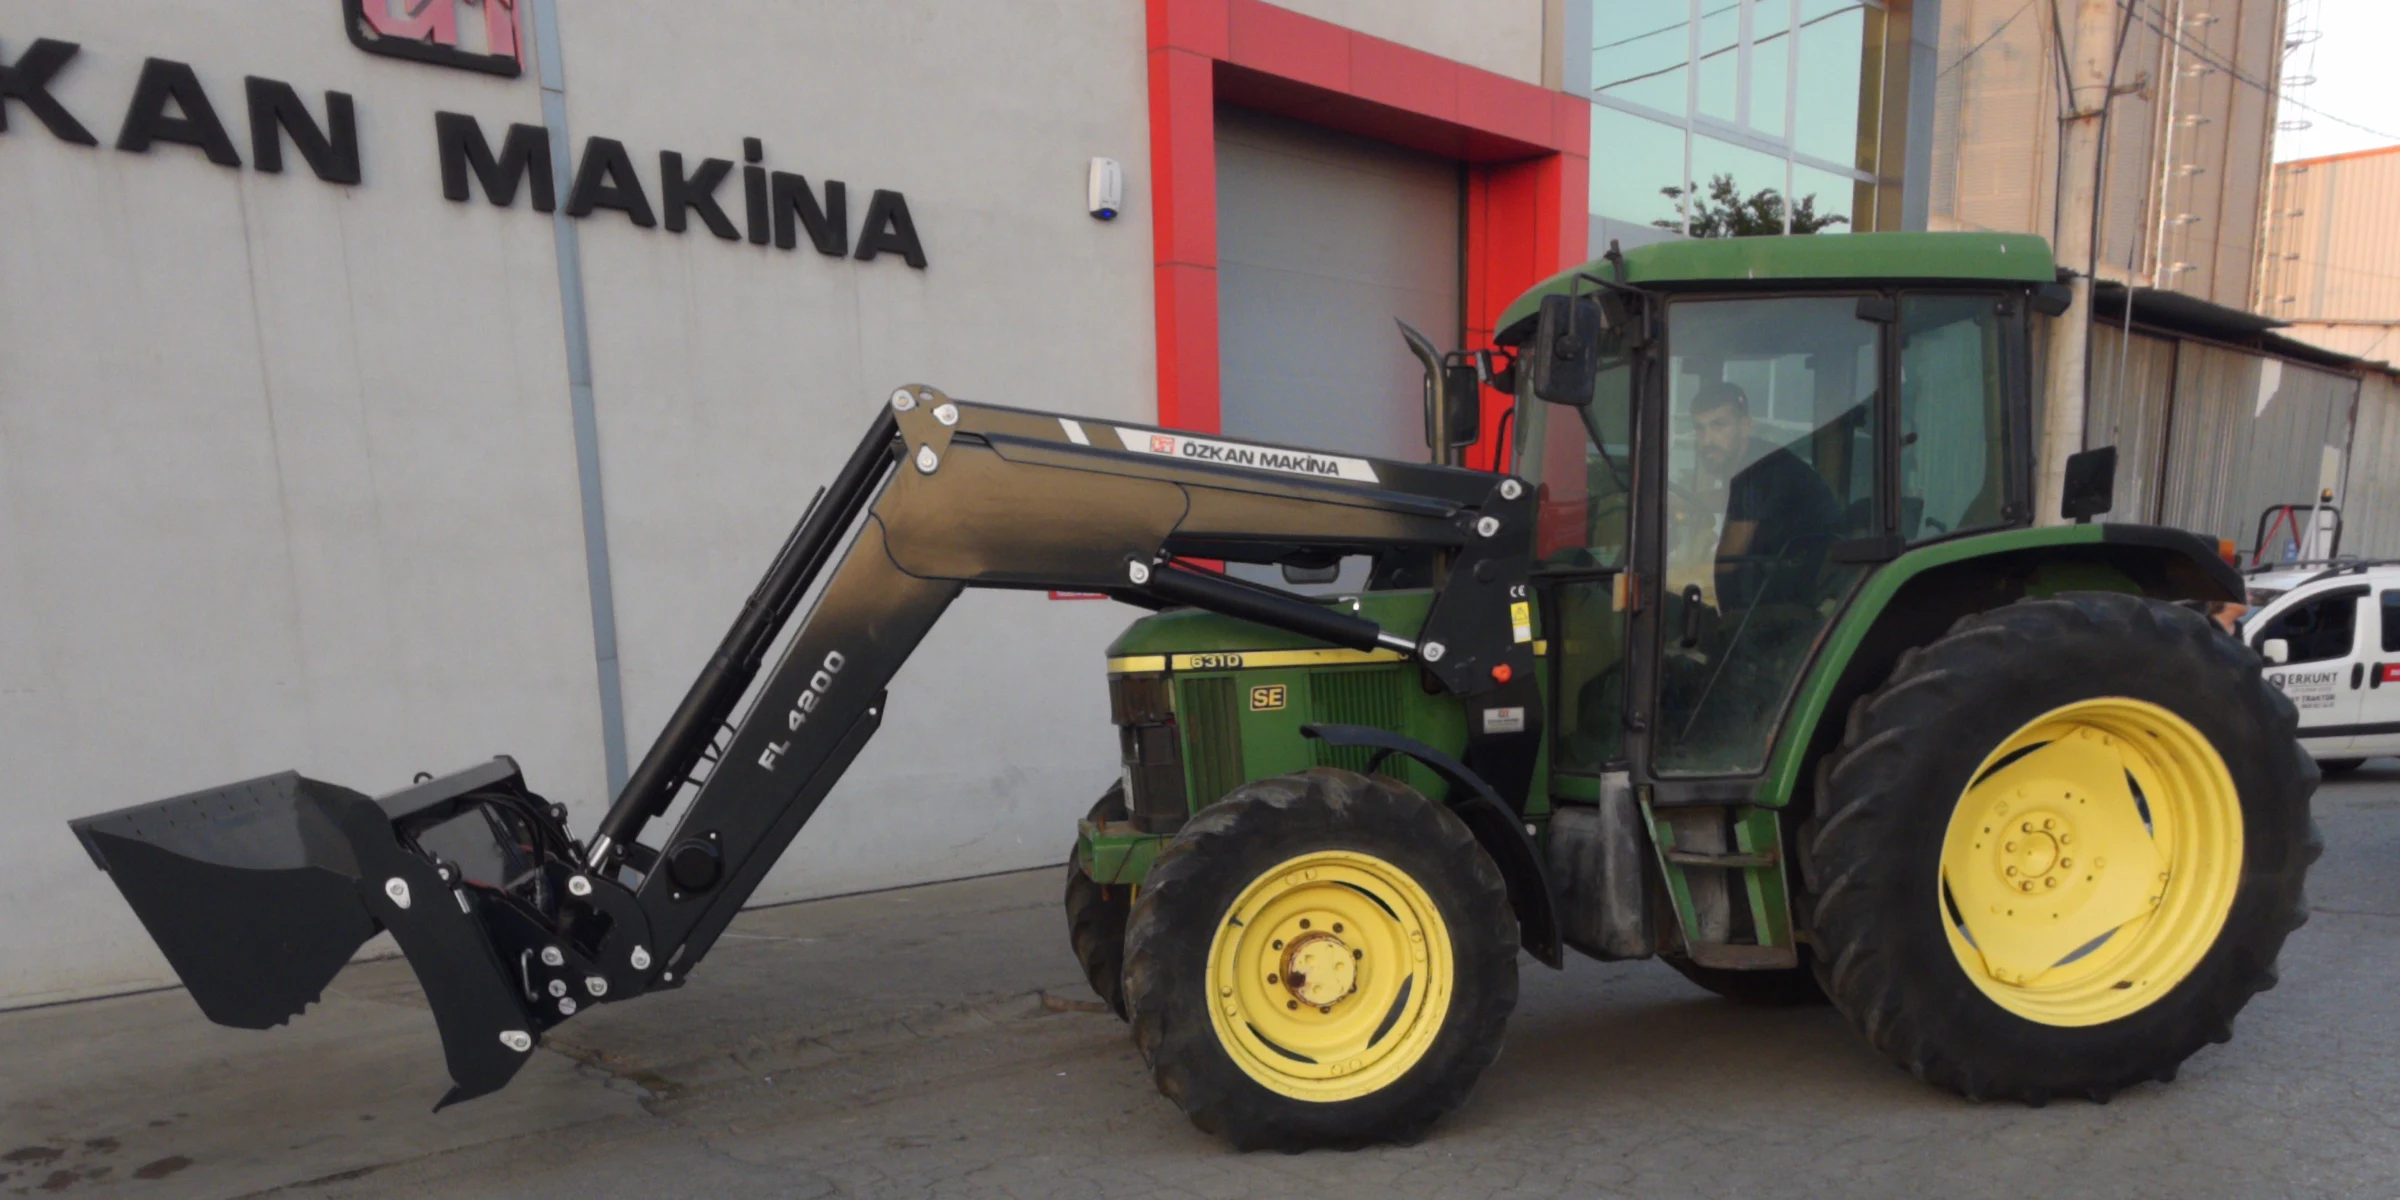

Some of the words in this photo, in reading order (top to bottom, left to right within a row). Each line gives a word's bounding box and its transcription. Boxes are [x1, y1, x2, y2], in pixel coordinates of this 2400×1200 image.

[435, 111, 928, 269] MAKİNA
[1182, 441, 1254, 465] ÖZKAN
[1260, 453, 1340, 475] MAKİNA
[1191, 654, 1242, 669] 6310
[2288, 672, 2338, 684] ERKUNT
[1253, 688, 1282, 707] SE
[757, 741, 791, 772] FL
[788, 650, 846, 732] 4200
